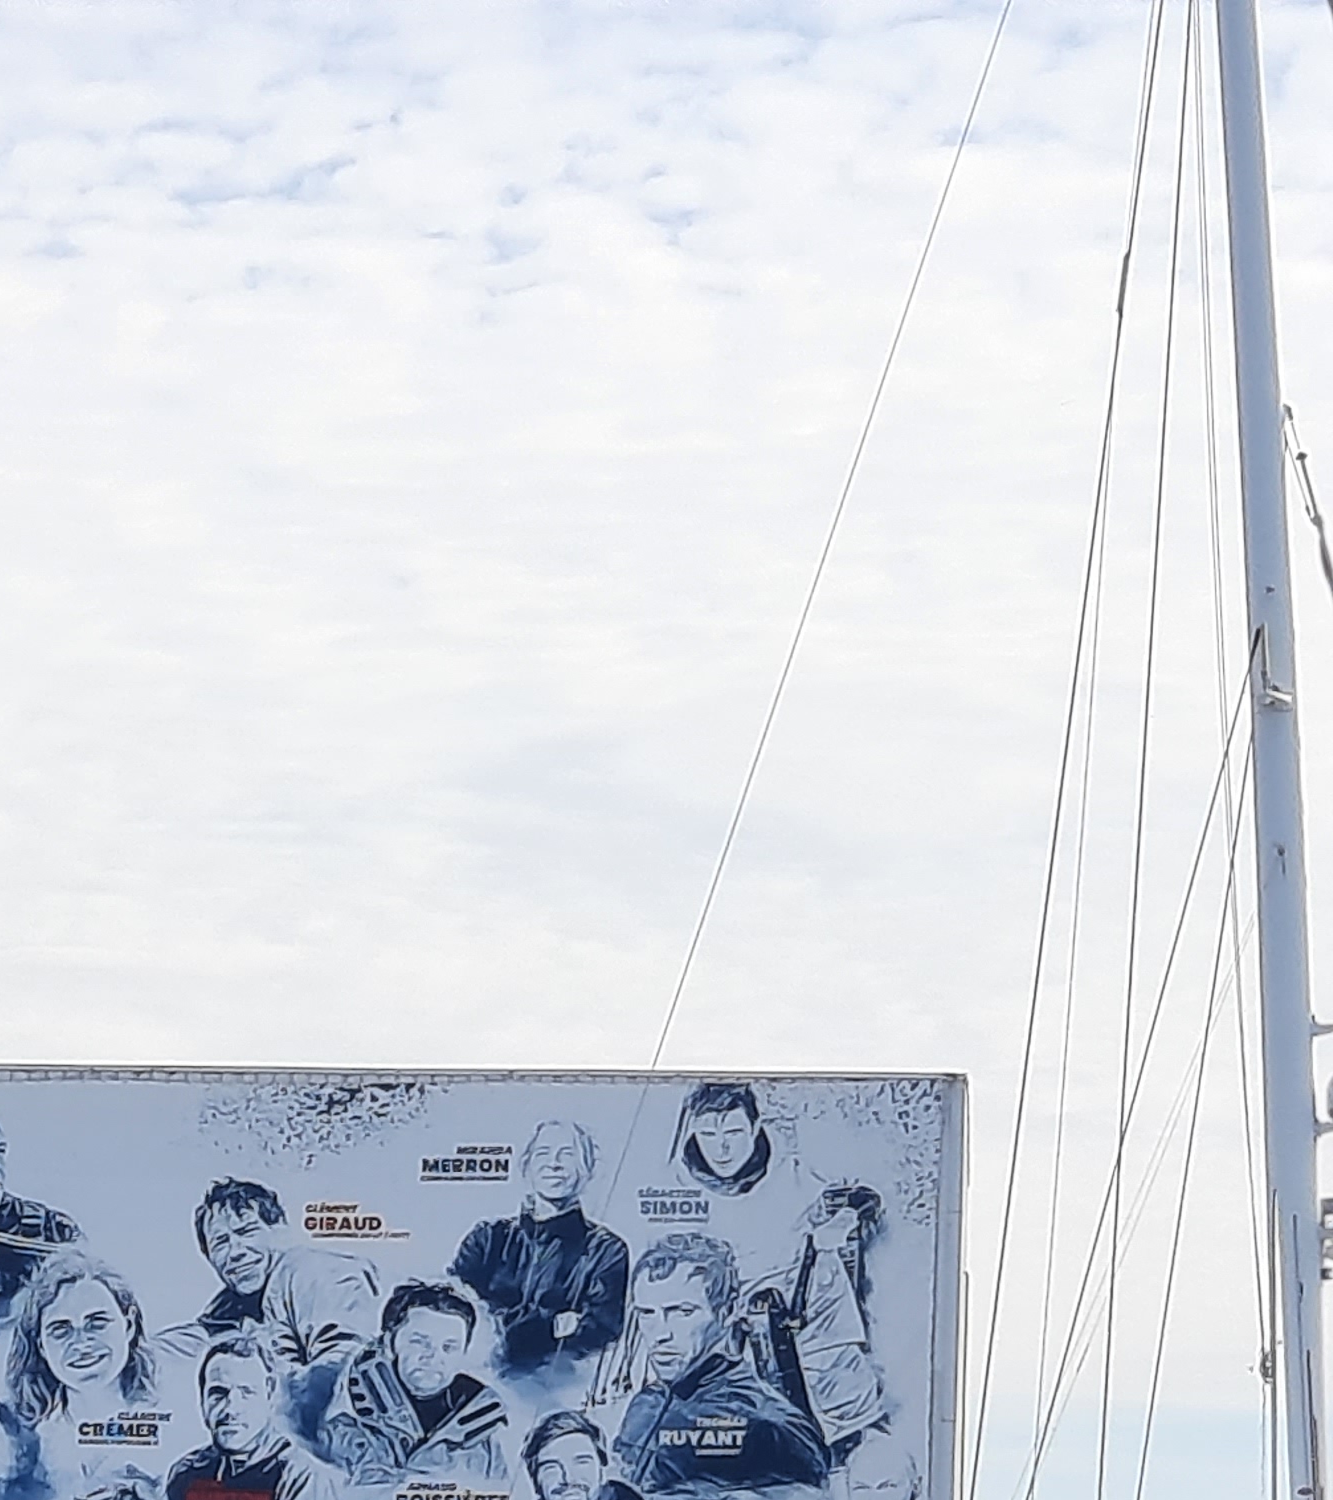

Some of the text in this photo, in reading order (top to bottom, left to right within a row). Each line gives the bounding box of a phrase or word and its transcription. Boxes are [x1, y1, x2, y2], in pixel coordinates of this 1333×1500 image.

[422, 1158, 509, 1173] MERRON
[640, 1200, 709, 1215] SIMON
[304, 1216, 382, 1231] GIRAUD
[659, 1430, 747, 1446] RUYANT
